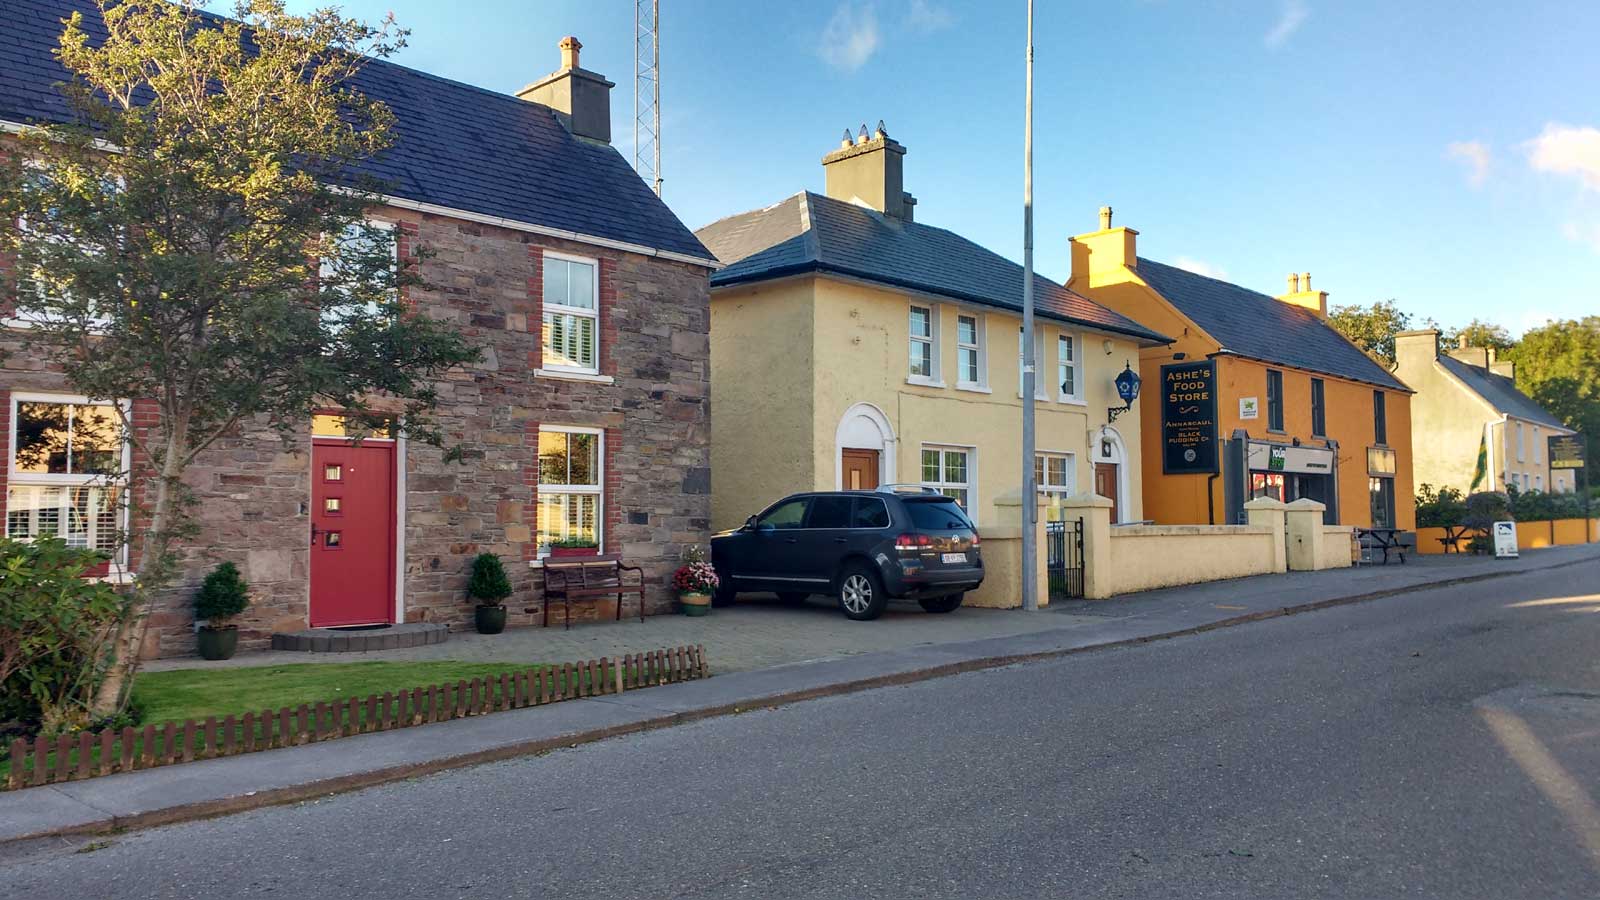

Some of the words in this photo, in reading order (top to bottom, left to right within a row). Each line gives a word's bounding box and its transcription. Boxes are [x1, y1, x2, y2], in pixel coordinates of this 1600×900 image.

[1167, 370, 1211, 381] ASHE'S
[1174, 381, 1205, 391] FOOD
[1170, 392, 1209, 402] STORE
